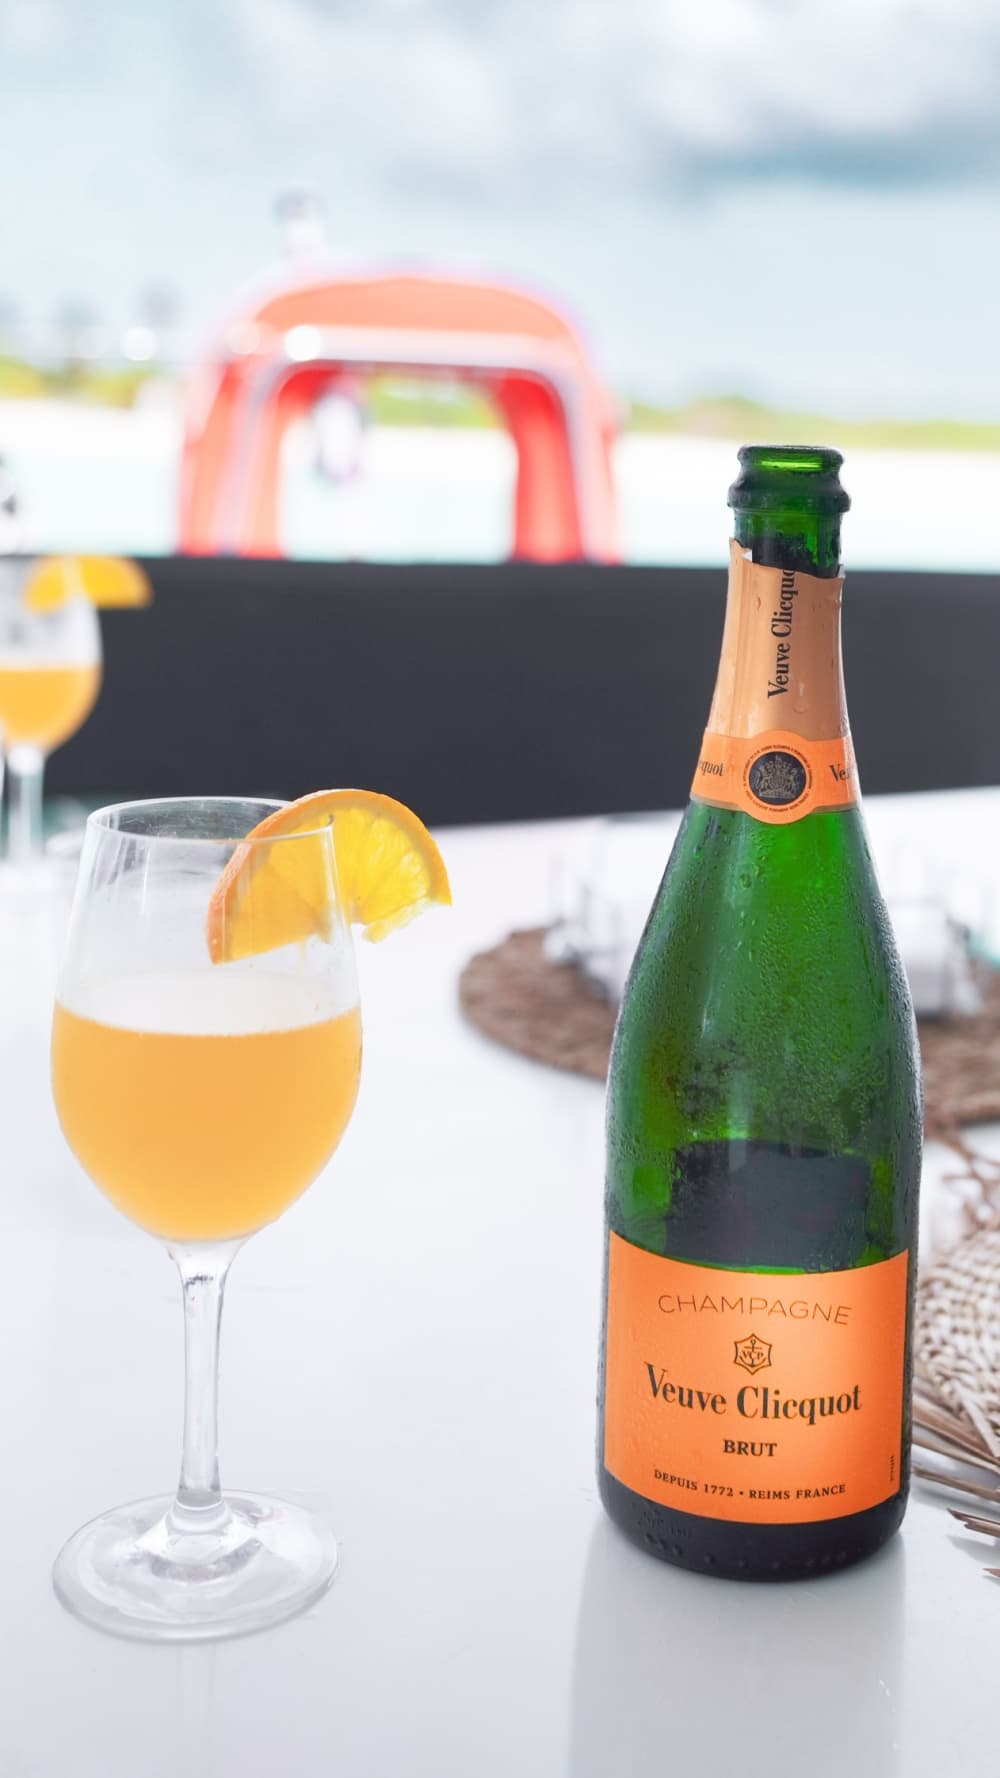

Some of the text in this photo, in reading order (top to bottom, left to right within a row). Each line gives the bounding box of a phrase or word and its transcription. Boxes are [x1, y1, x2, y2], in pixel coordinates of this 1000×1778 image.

[767, 642, 791, 699] Veuve
[699, 760, 724, 777] quot
[658, 1294, 853, 1326] CHAMPAGNE
[644, 1361, 862, 1426] Veuve Clicquot
[723, 1439, 778, 1457] BRUT
[654, 1469, 846, 1500] DEPUIS 1772 REIMS FRANCE
